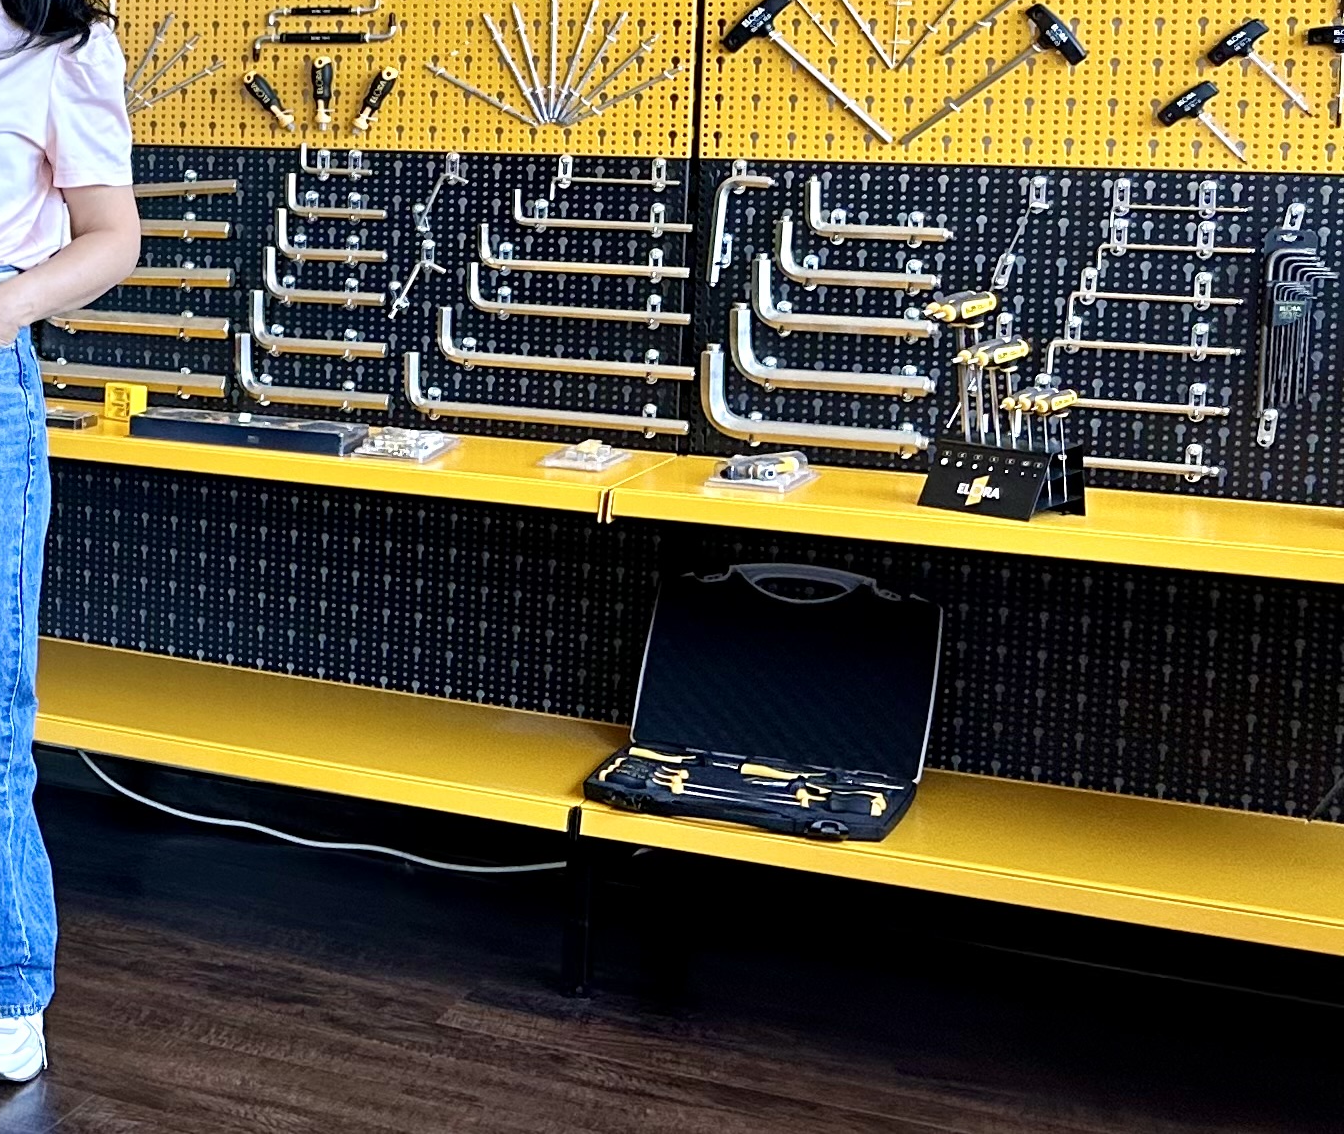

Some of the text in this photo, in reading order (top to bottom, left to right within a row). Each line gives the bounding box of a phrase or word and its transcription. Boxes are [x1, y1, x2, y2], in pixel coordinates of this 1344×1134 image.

[250, 82, 270, 104] ELORA
[370, 80, 387, 104] ELORA
[957, 482, 1000, 500] ELORA
